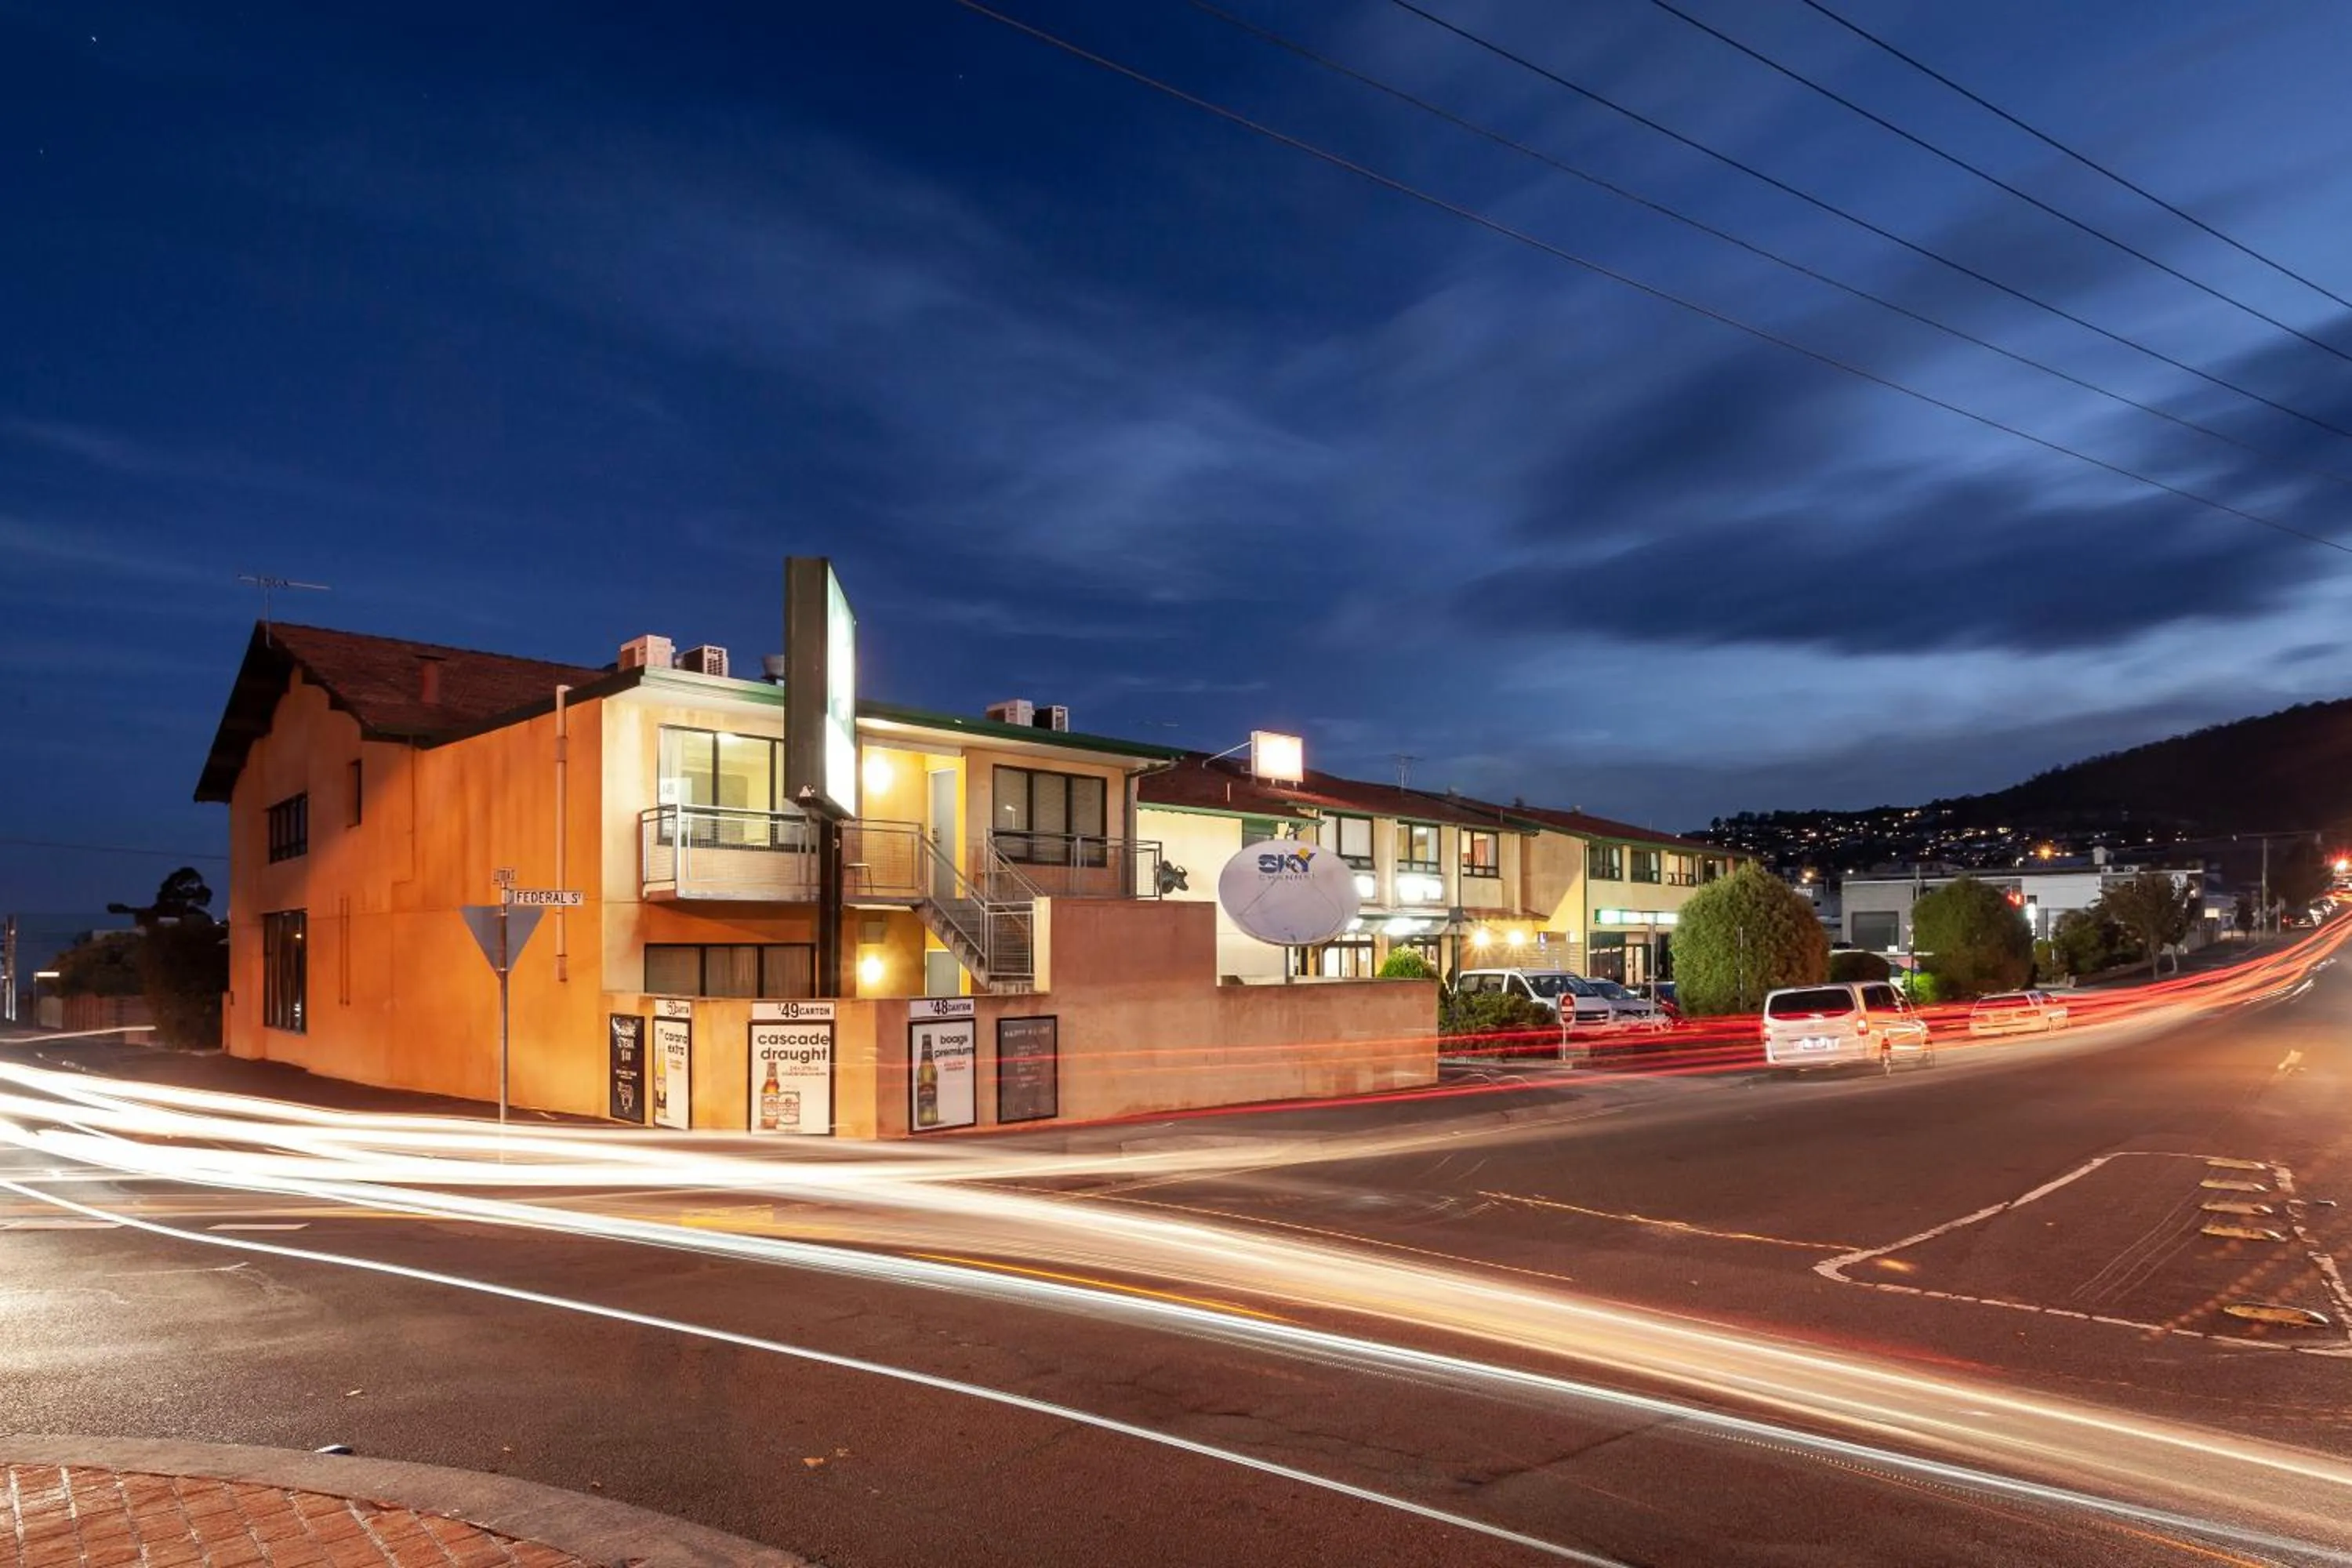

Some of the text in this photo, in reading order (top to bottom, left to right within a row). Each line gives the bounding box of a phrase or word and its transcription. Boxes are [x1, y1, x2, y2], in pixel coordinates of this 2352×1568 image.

[1258, 852, 1316, 873] SKY
[517, 891, 567, 904] FEDERAL
[799, 1007, 830, 1015] CARTON
[757, 1033, 829, 1045] cascade
[760, 1047, 828, 1063] draught
